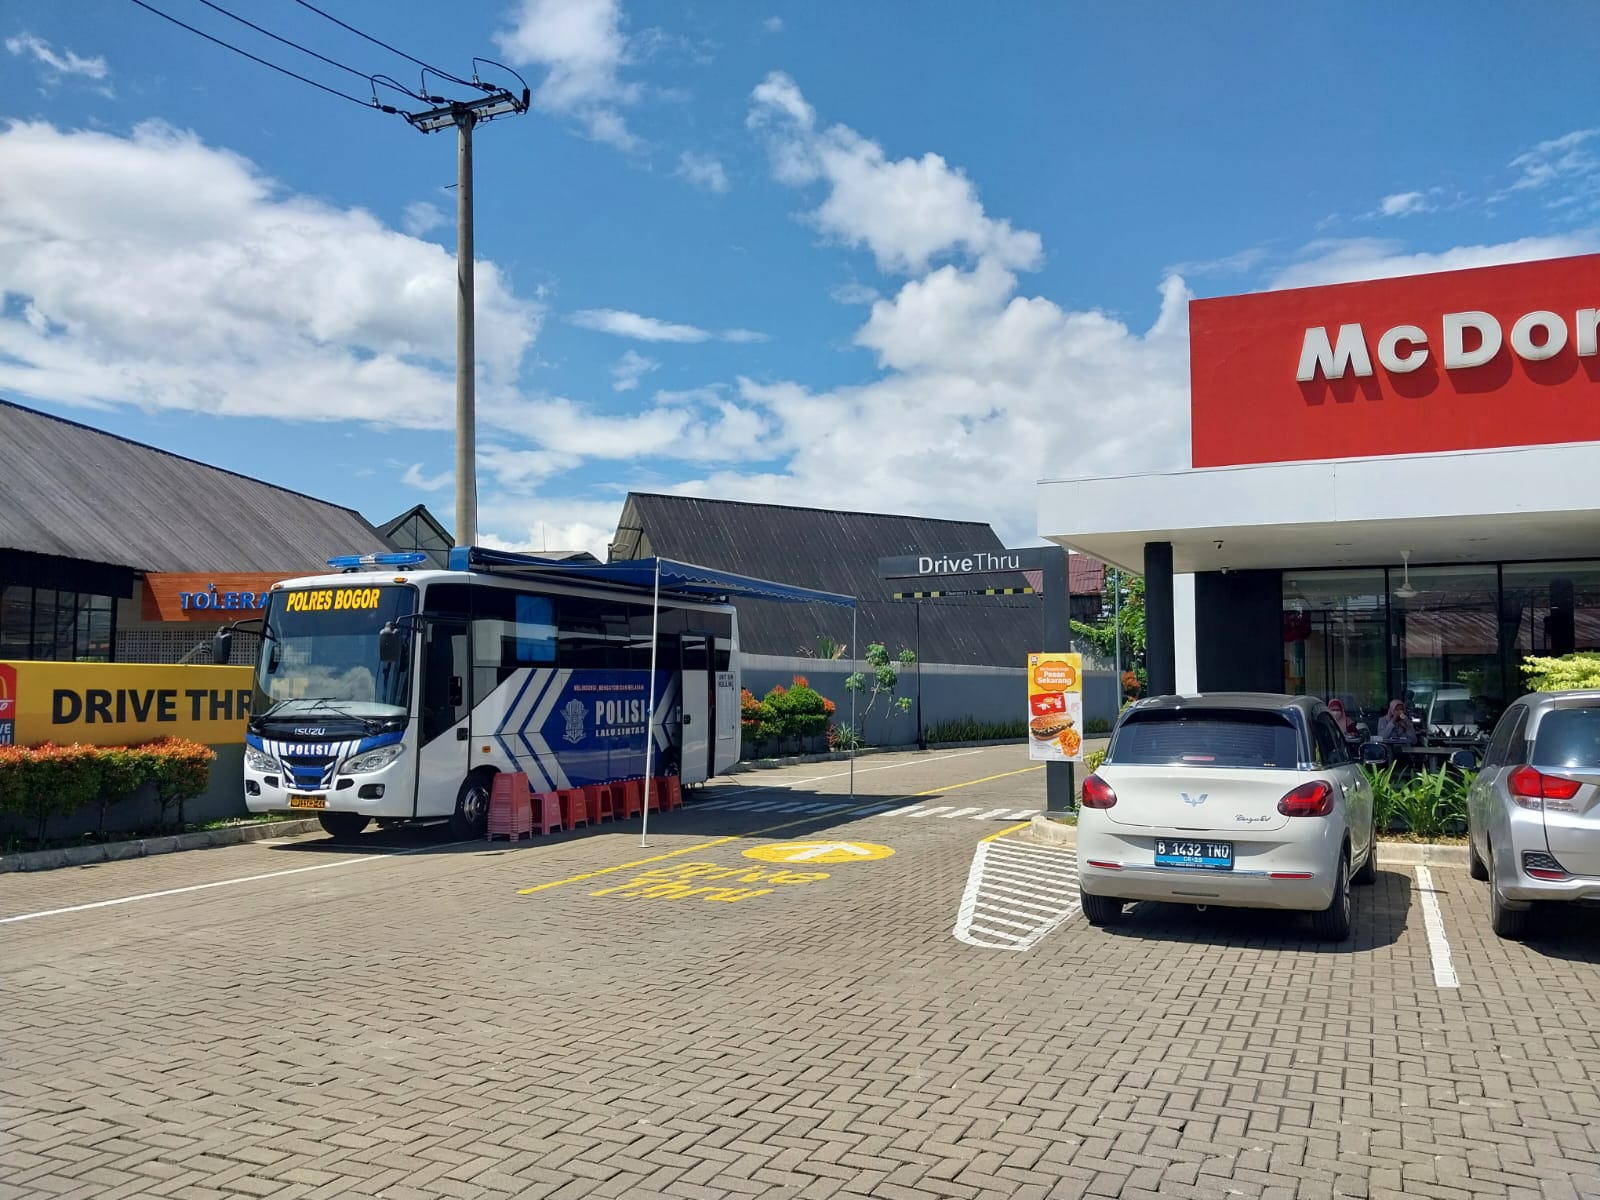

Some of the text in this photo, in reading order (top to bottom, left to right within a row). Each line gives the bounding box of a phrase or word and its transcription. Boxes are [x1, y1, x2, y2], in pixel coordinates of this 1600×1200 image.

[286, 588, 381, 612] POLRES BOGOR
[52, 688, 178, 725] DRIVE
[595, 699, 646, 725] POLISI
[294, 727, 326, 736] ISUZU
[595, 728, 616, 738] LALU
[288, 744, 329, 756] POLISI
[1158, 842, 1166, 855] B
[1171, 843, 1202, 857] 1432
[638, 862, 830, 884] Drive
[588, 878, 775, 903] Thru
